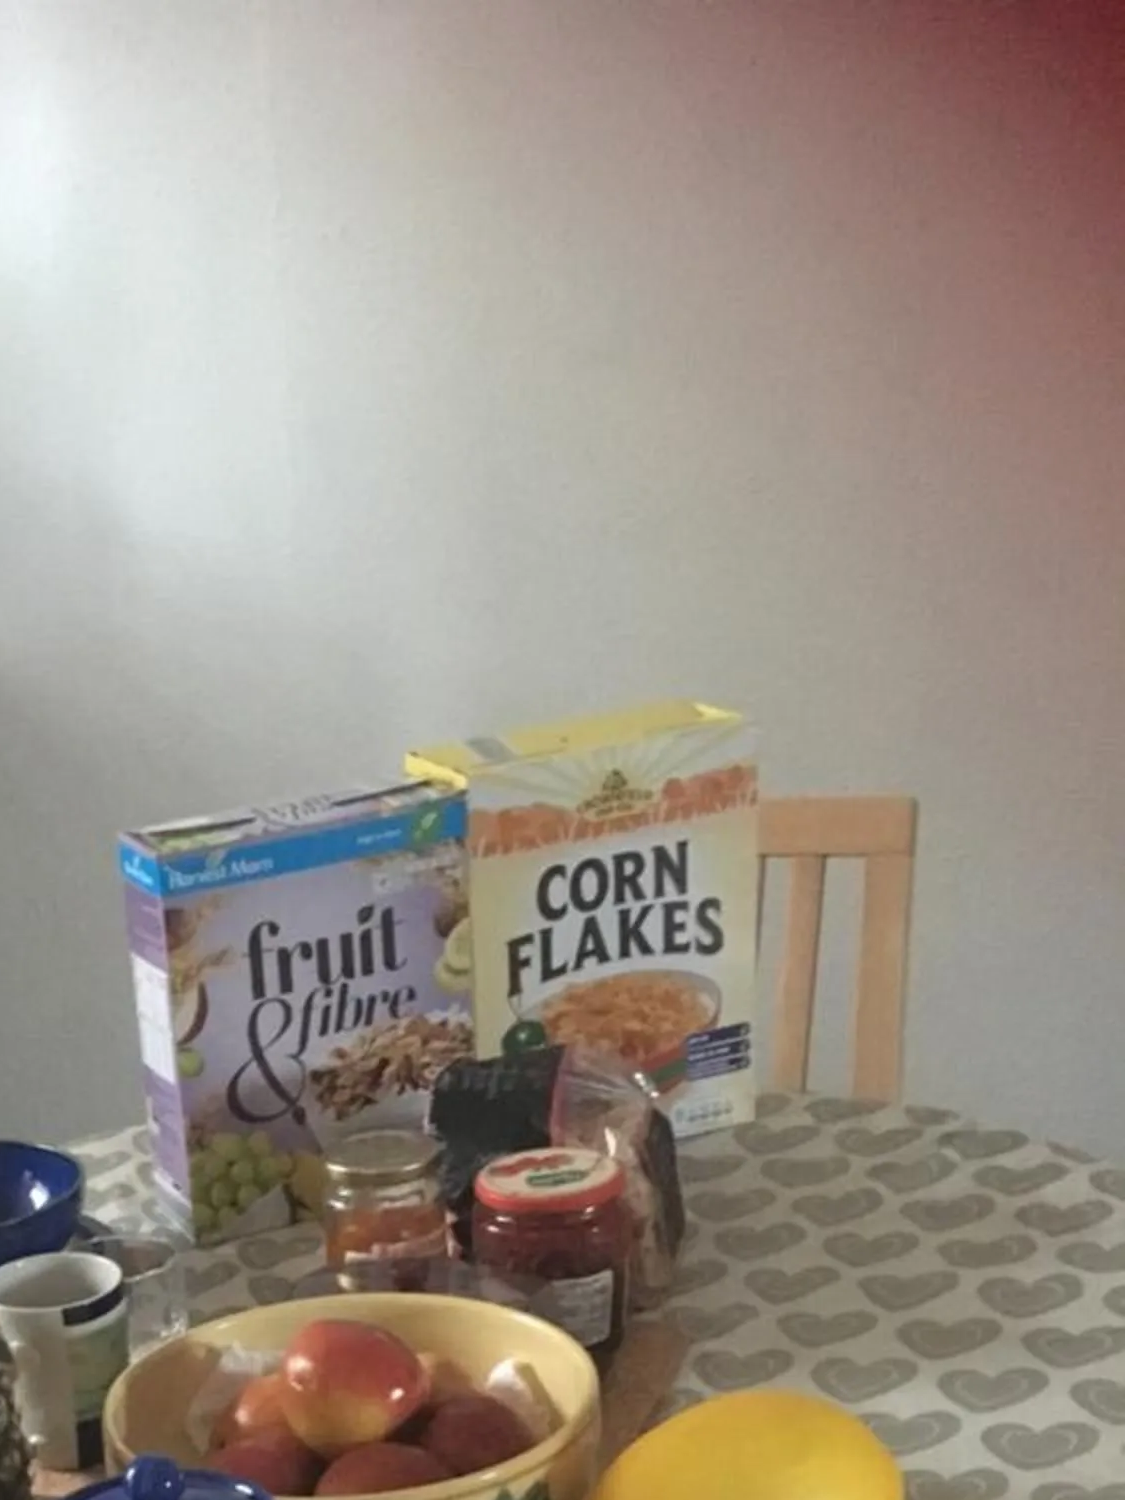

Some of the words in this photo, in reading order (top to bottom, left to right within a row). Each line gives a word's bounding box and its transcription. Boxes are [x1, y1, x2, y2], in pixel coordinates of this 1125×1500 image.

[536, 839, 689, 921] CORN
[243, 904, 408, 1001] fruit
[506, 897, 724, 999] FLAKES
[286, 982, 417, 1060] fibre
